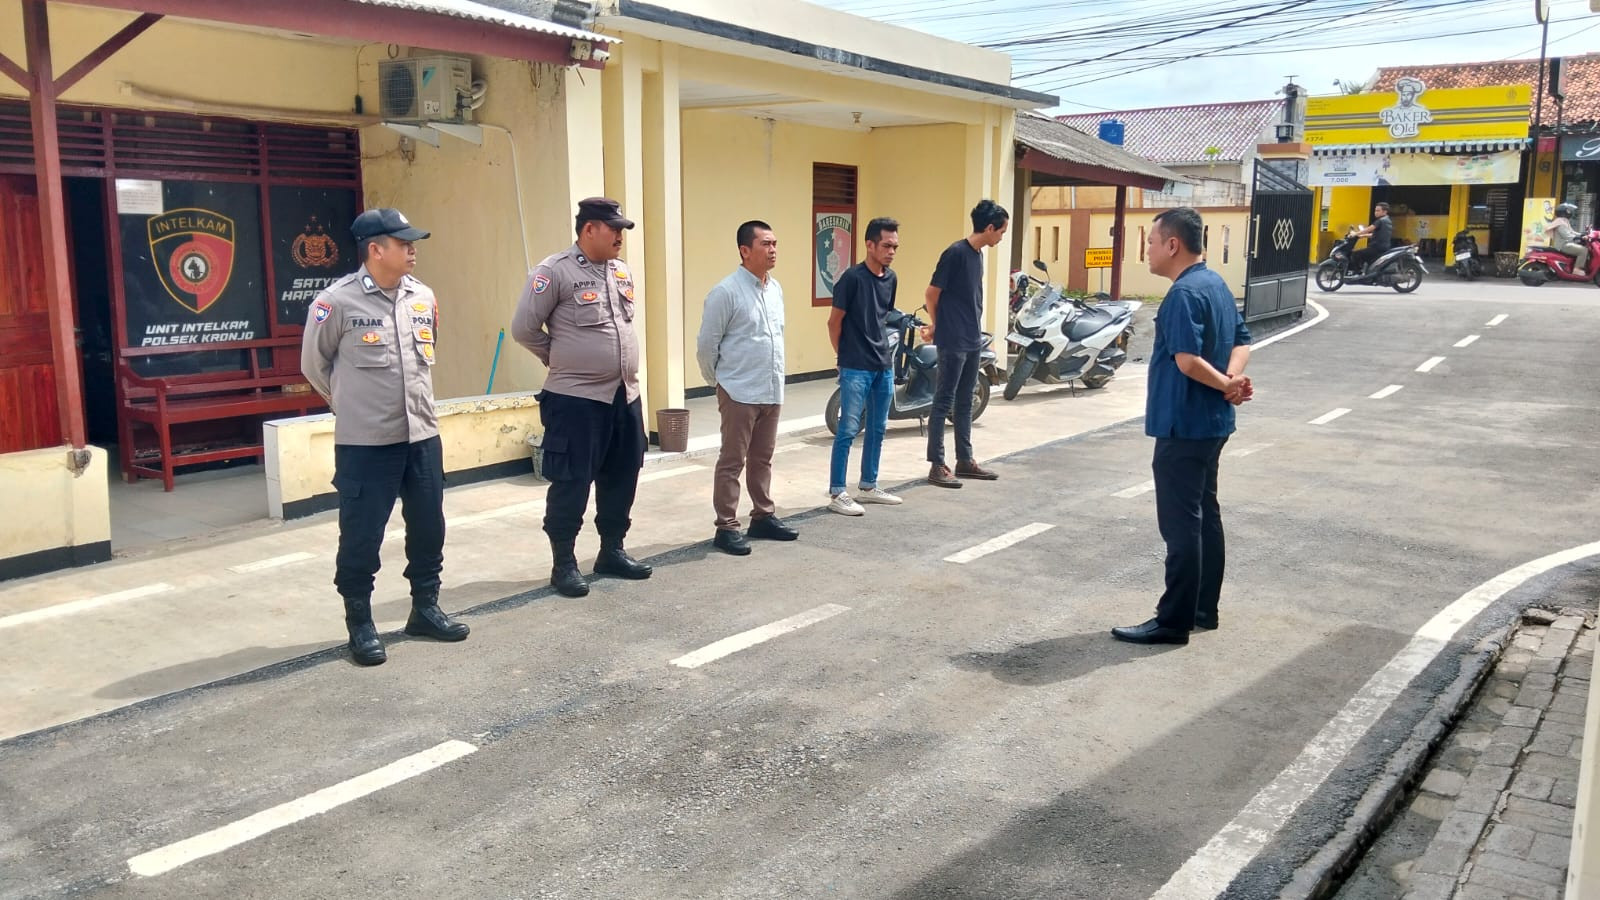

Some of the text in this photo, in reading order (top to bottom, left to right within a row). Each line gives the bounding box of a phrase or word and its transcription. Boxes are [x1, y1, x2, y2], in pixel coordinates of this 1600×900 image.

[1381, 110, 1430, 122] BAKER
[1391, 123, 1417, 136] Old
[156, 216, 227, 233] INTELKAM
[145, 320, 249, 335] UNIT INTELKAM
[352, 318, 384, 327] FAJAR
[141, 331, 254, 347] POLSEK KRONJO
